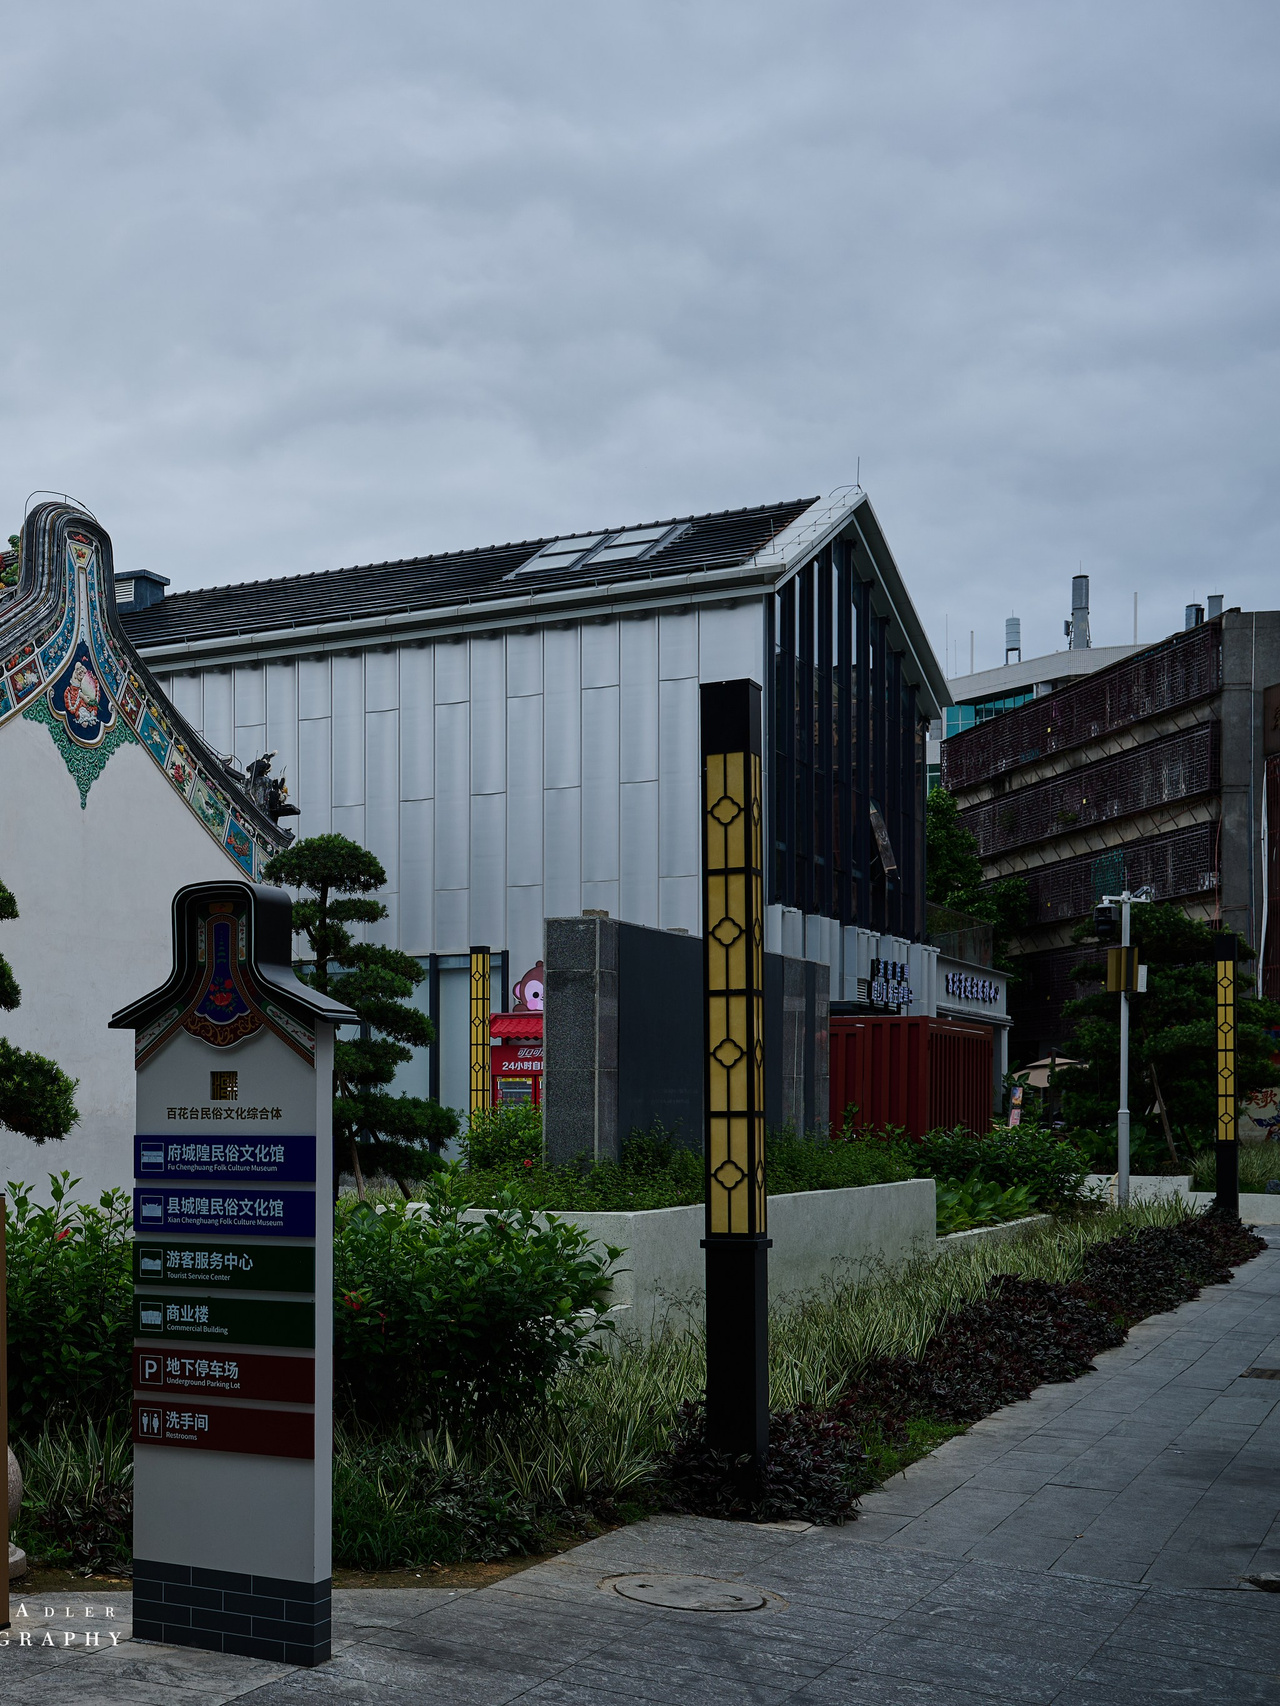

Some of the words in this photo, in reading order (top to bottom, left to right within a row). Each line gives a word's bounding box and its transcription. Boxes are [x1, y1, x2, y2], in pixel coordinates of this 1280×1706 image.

[502, 1062, 543, 1071] 24小时自
[1239, 1089, 1278, 1110] 英歌
[166, 1107, 283, 1121] 百花台民俗文化综合体
[167, 1144, 285, 1163] 府城隍民俗文化馆
[176, 1163, 214, 1173] Chenghuang
[214, 1164, 227, 1172] Folk
[227, 1164, 251, 1172] Culture
[166, 1197, 284, 1218] 县城隍民俗文化馆
[181, 1216, 219, 1226] Chenghuang
[219, 1217, 233, 1225] Folk
[233, 1218, 256, 1226] Culture
[256, 1219, 284, 1227] Museum
[166, 1250, 254, 1271] 游客服务中心
[167, 1272, 187, 1280] Tourist
[187, 1273, 209, 1281] Service
[210, 1273, 231, 1281] Center
[166, 1304, 209, 1323] 商业楼
[166, 1323, 202, 1333] Commercial
[203, 1325, 229, 1336] Building
[144, 1359, 158, 1379] P
[166, 1357, 239, 1380] 地下停车场
[166, 1378, 206, 1388] Underground
[206, 1380, 230, 1390] Parking
[230, 1382, 241, 1390] Lot
[165, 1410, 209, 1432] 洗手间
[165, 1431, 197, 1441] Restrooms
